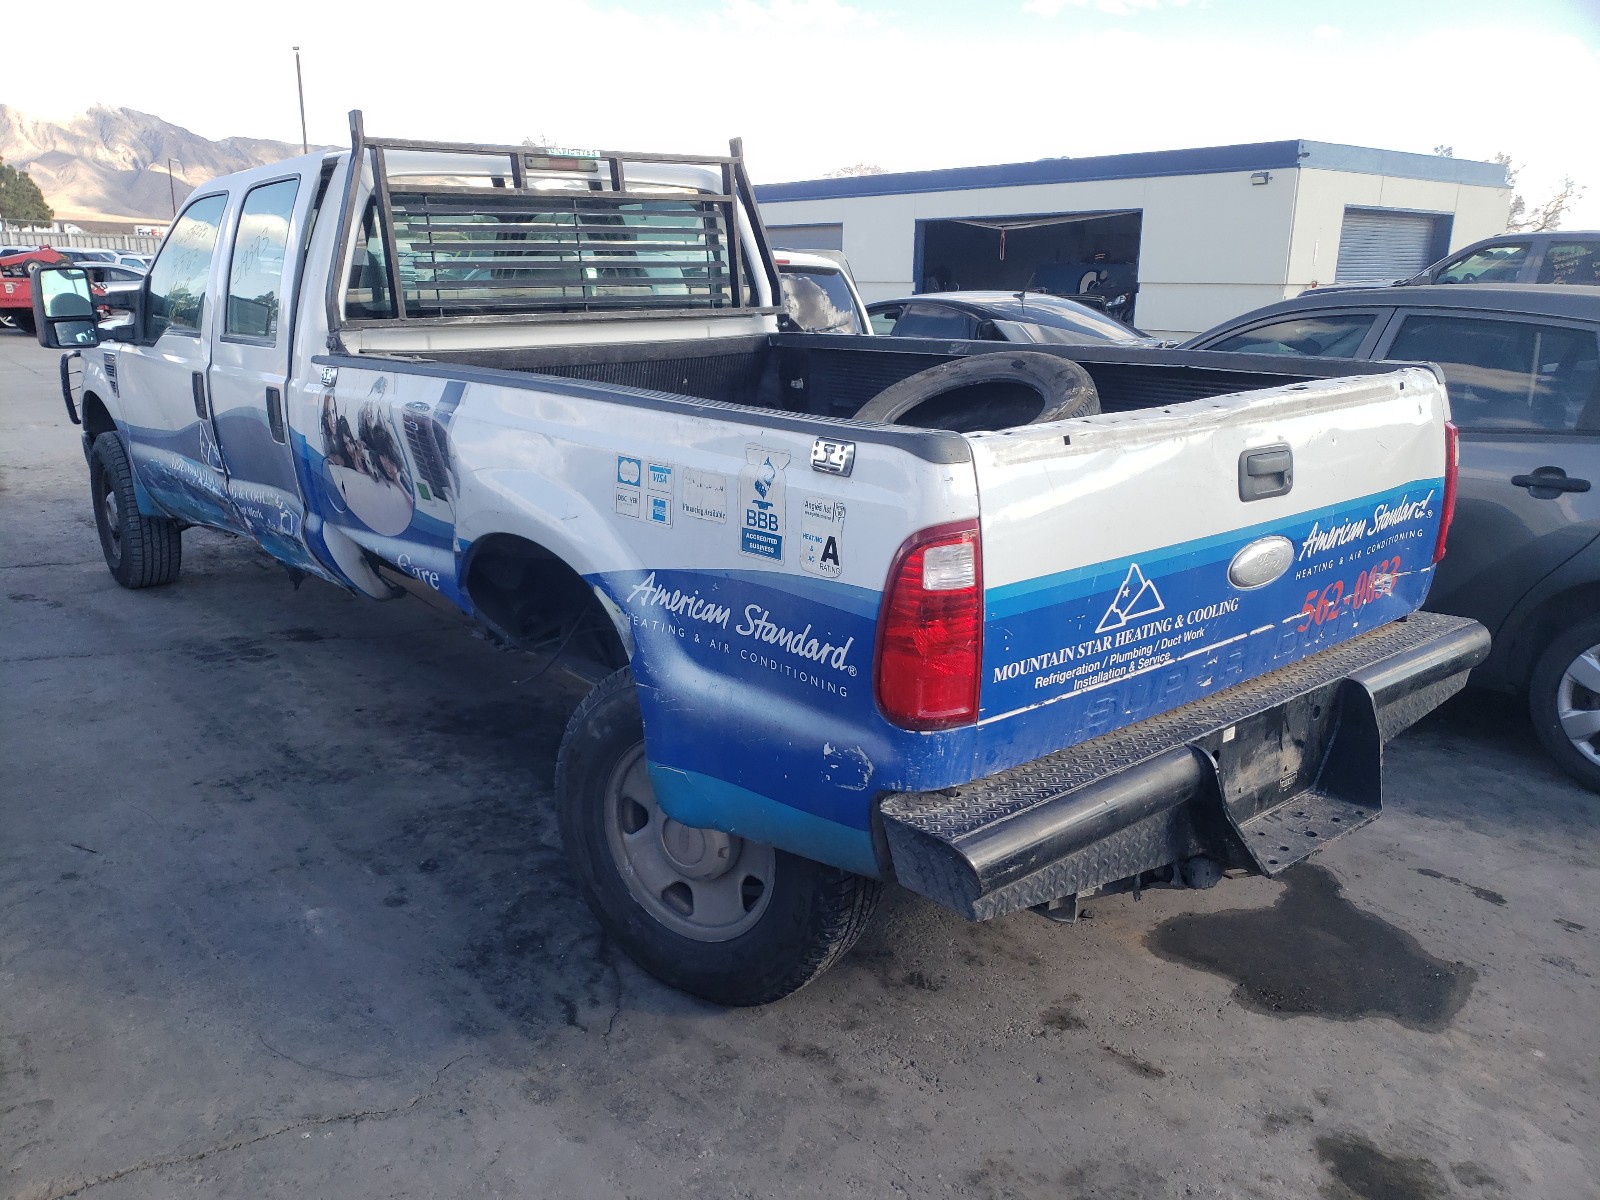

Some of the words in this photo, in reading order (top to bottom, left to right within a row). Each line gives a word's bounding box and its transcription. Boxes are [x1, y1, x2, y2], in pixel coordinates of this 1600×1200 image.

[653, 473, 667, 484] VISA
[618, 494, 638, 503] DISCVER
[683, 503, 703, 516] Financing
[704, 508, 726, 519] Available
[746, 508, 779, 532] BBB
[745, 532, 778, 545] ACCREDITED
[749, 542, 775, 554] BUSINESS
[803, 533, 823, 544] HEATING
[821, 536, 840, 566] A
[1299, 517, 1367, 561] American
[1296, 560, 1334, 580] HEATING
[1338, 557, 1344, 565] &
[1349, 550, 1362, 562] AIR
[1366, 529, 1423, 555] CONDITIONING
[819, 562, 841, 575] RATING
[626, 571, 731, 630] American
[992, 645, 1076, 684] MOUNTAIN
[1077, 635, 1112, 659] STAR
[1114, 617, 1172, 648] HEATING
[1174, 614, 1184, 629] &
[1187, 597, 1239, 625] COOLING
[626, 613, 685, 637] HEATING
[694, 633, 700, 643] &
[709, 639, 730, 654] AIR
[740, 649, 848, 697] CONDITIONING
[1034, 661, 1101, 689] Refrigeration
[1109, 644, 1153, 667] Plumbing
[1161, 634, 1182, 649] Duct
[1183, 627, 1205, 642] Work
[1073, 665, 1126, 691] Installation
[1128, 660, 1136, 673] &
[1138, 652, 1171, 670] Service
